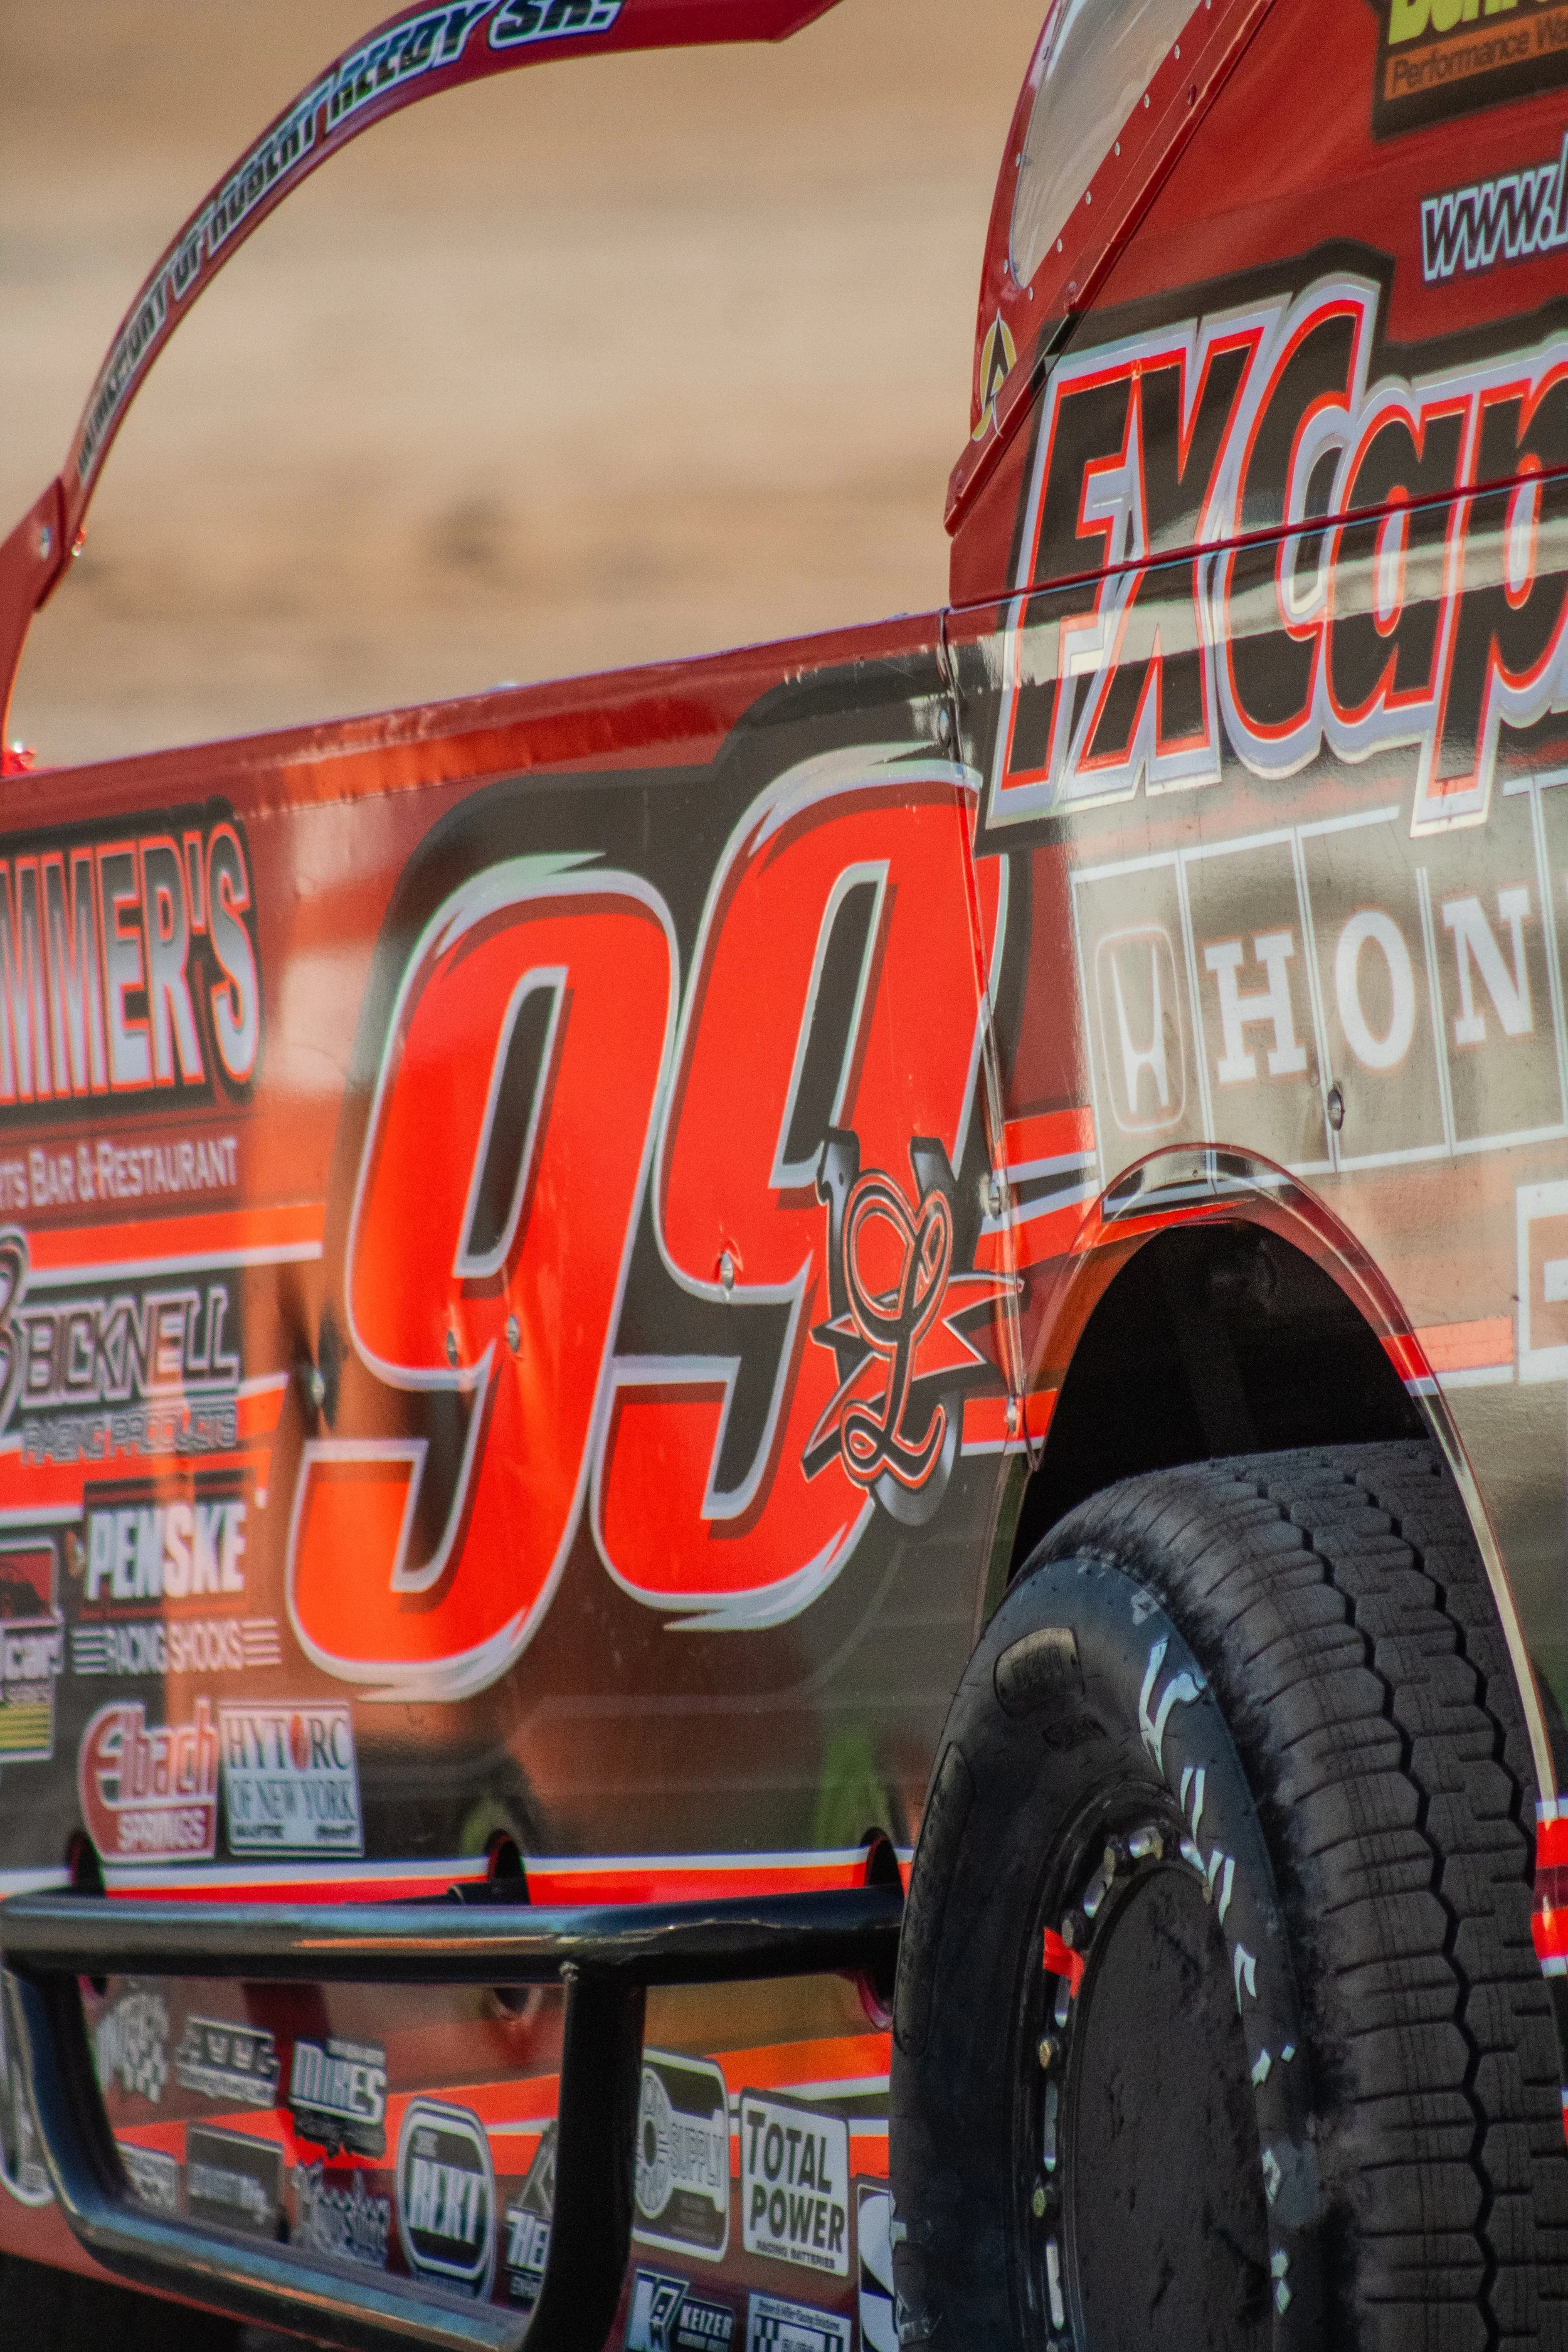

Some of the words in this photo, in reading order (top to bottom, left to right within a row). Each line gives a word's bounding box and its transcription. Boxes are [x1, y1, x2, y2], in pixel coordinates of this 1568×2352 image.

[1393, 29, 1530, 93] Performance
[286, 741, 1007, 1701] 99
[85, 1501, 247, 1601] PENSKE
[746, 2109, 832, 2195] TOTAL
[750, 2183, 845, 2254] POWER
[679, 2302, 733, 2341] KEIZER
